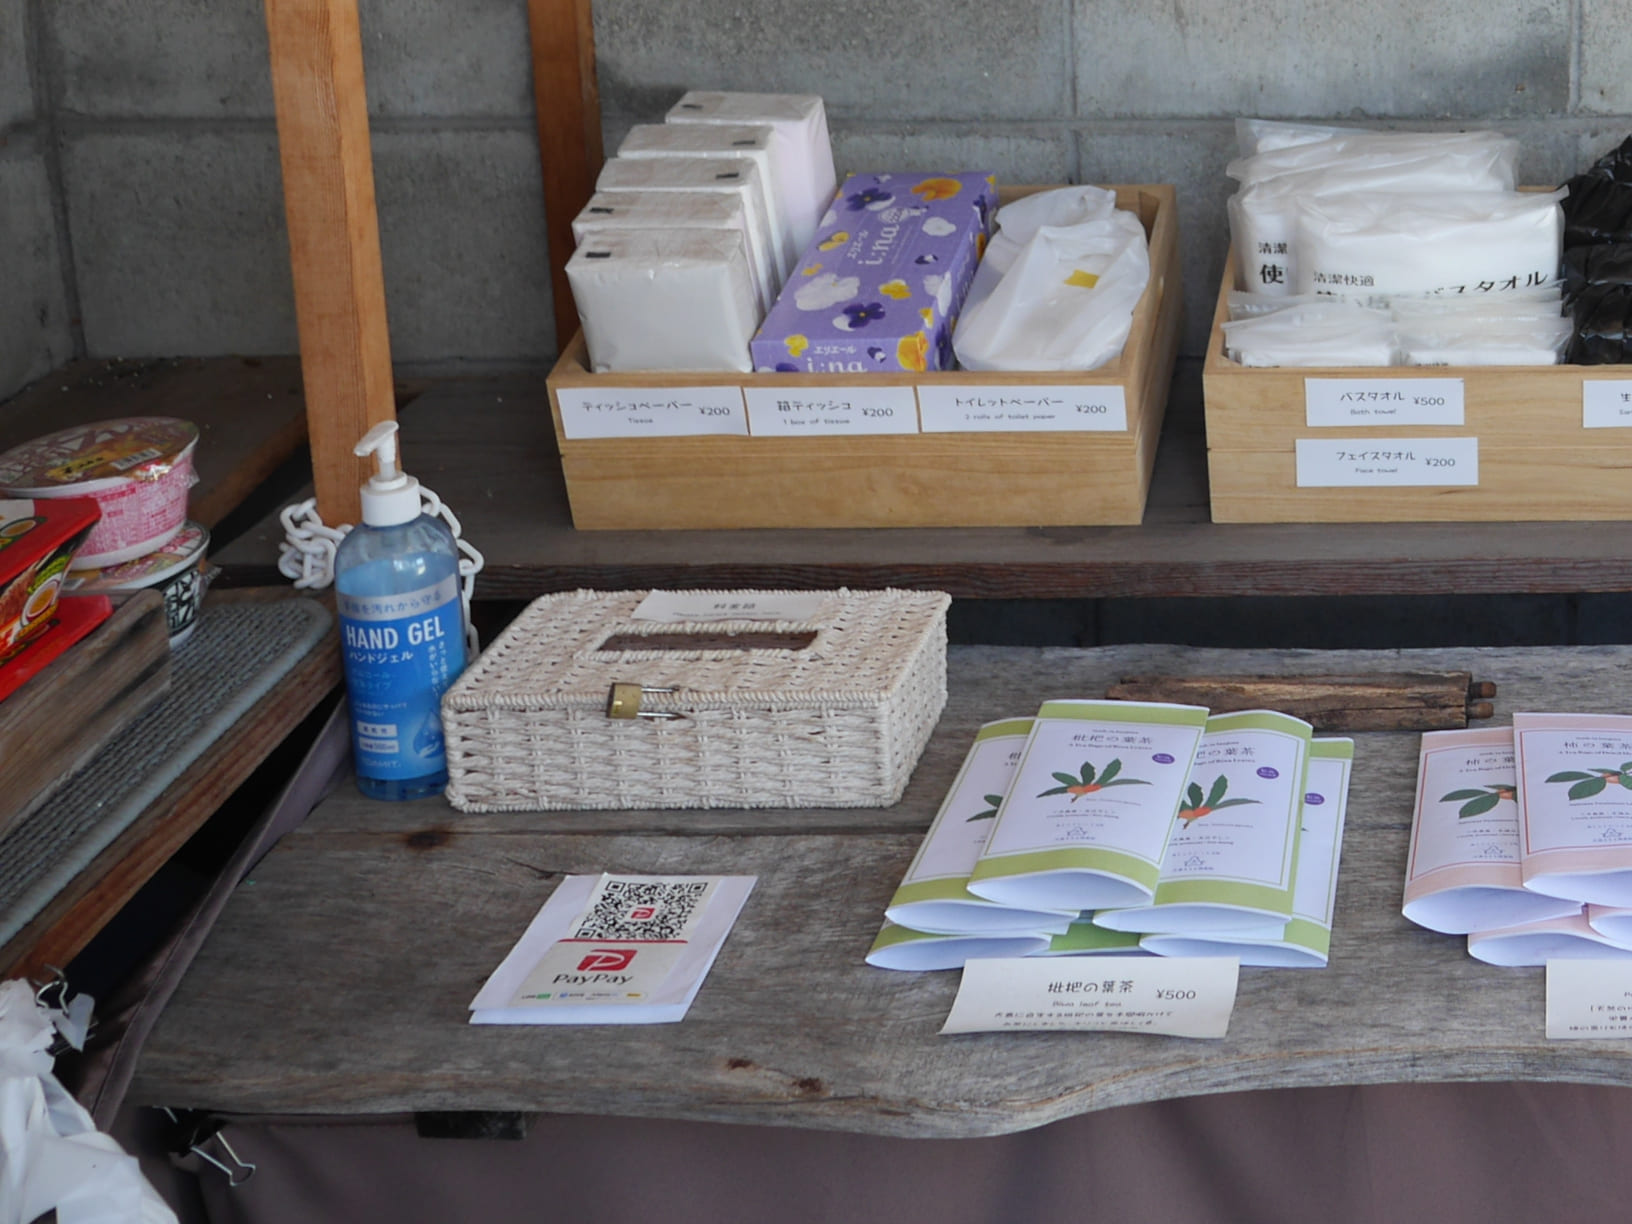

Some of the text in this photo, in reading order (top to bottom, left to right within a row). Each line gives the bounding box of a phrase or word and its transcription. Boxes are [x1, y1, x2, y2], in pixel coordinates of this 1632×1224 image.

[955, 397, 1107, 414] トイレットペーパー ¥200
[1340, 391, 1446, 406] バスタオル ¥500
[699, 406, 731, 416] ¥200
[862, 407, 894, 417] ¥200
[1336, 451, 1456, 467] フェイスタオル ¥200
[345, 615, 445, 650] HAND GEL
[349, 650, 414, 665] ハンドジェル
[552, 973, 633, 985] PayPay
[1048, 980, 1197, 1000] 枇杷の葉茶 ¥500
